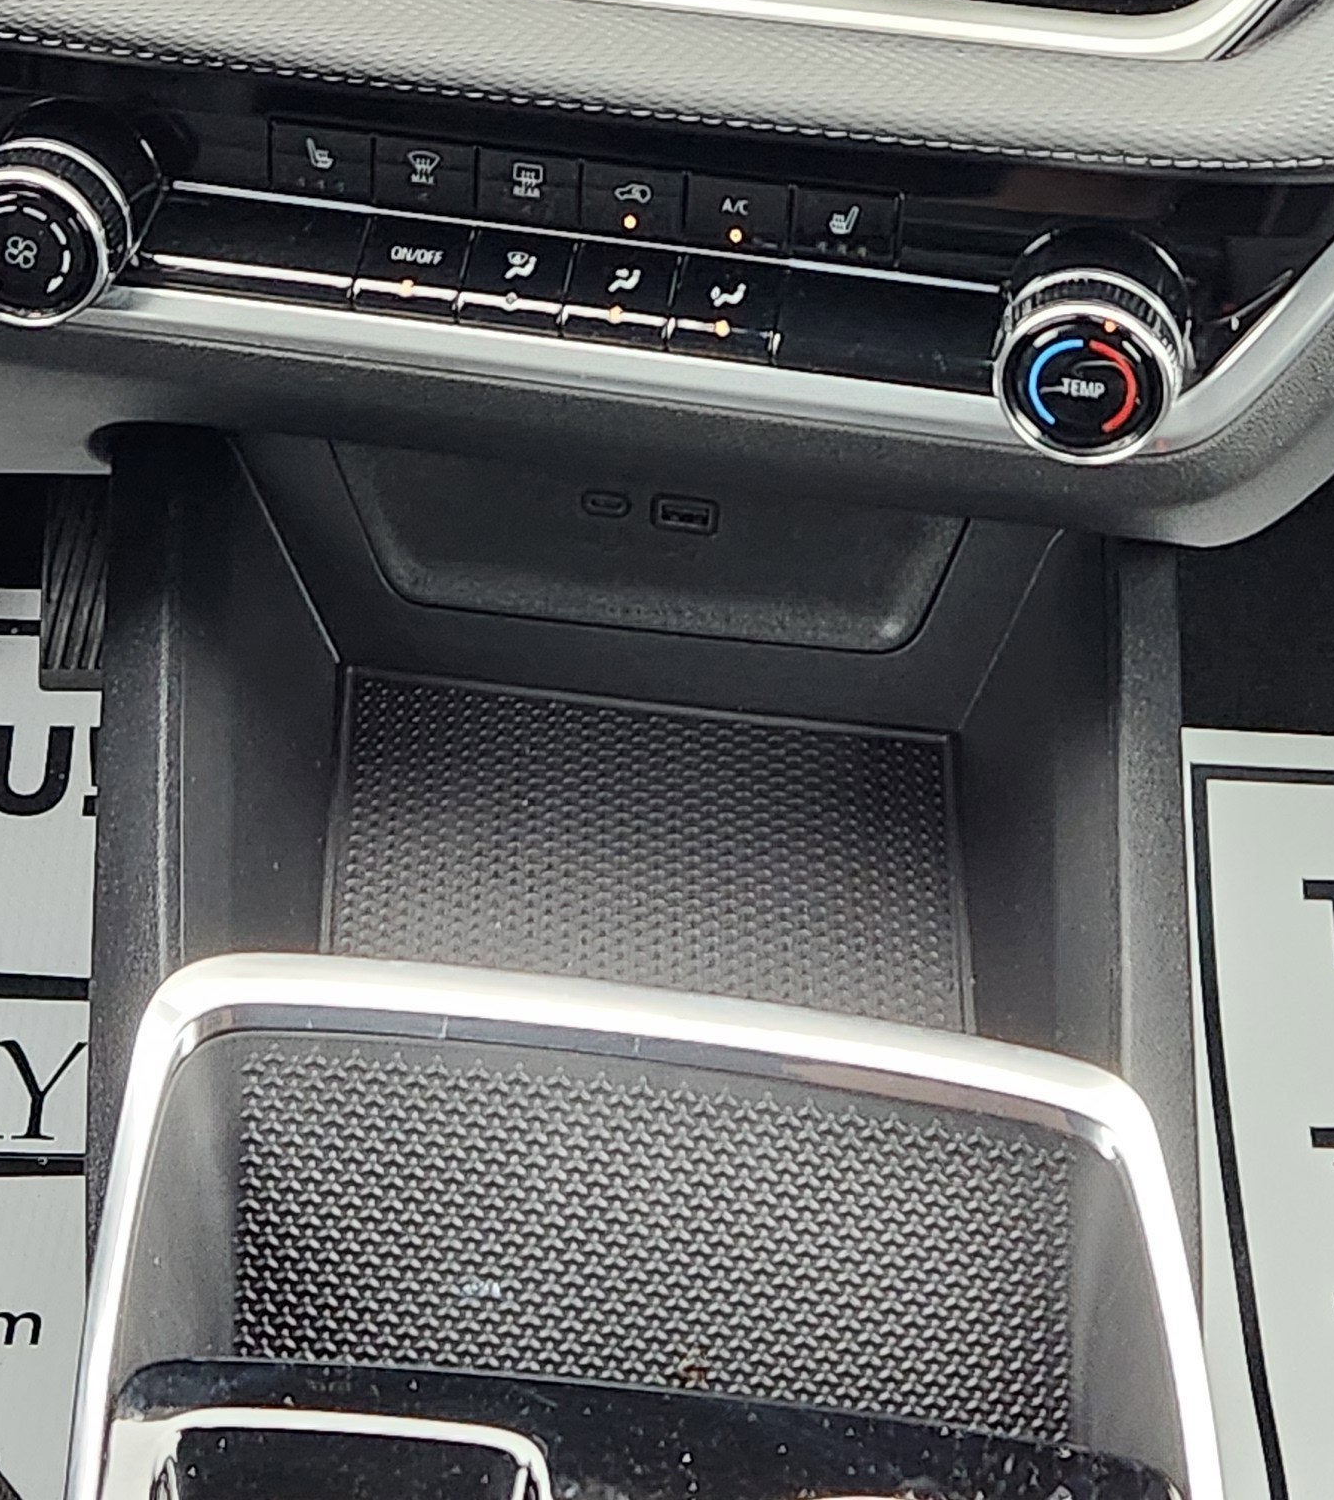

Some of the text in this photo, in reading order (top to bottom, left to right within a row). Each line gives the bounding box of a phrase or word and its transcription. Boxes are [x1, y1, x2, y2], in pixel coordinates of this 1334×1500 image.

[410, 173, 435, 185] MAX
[721, 197, 750, 217] A/C
[390, 245, 445, 266] ON/OFF
[1060, 377, 1106, 399] TEMP
